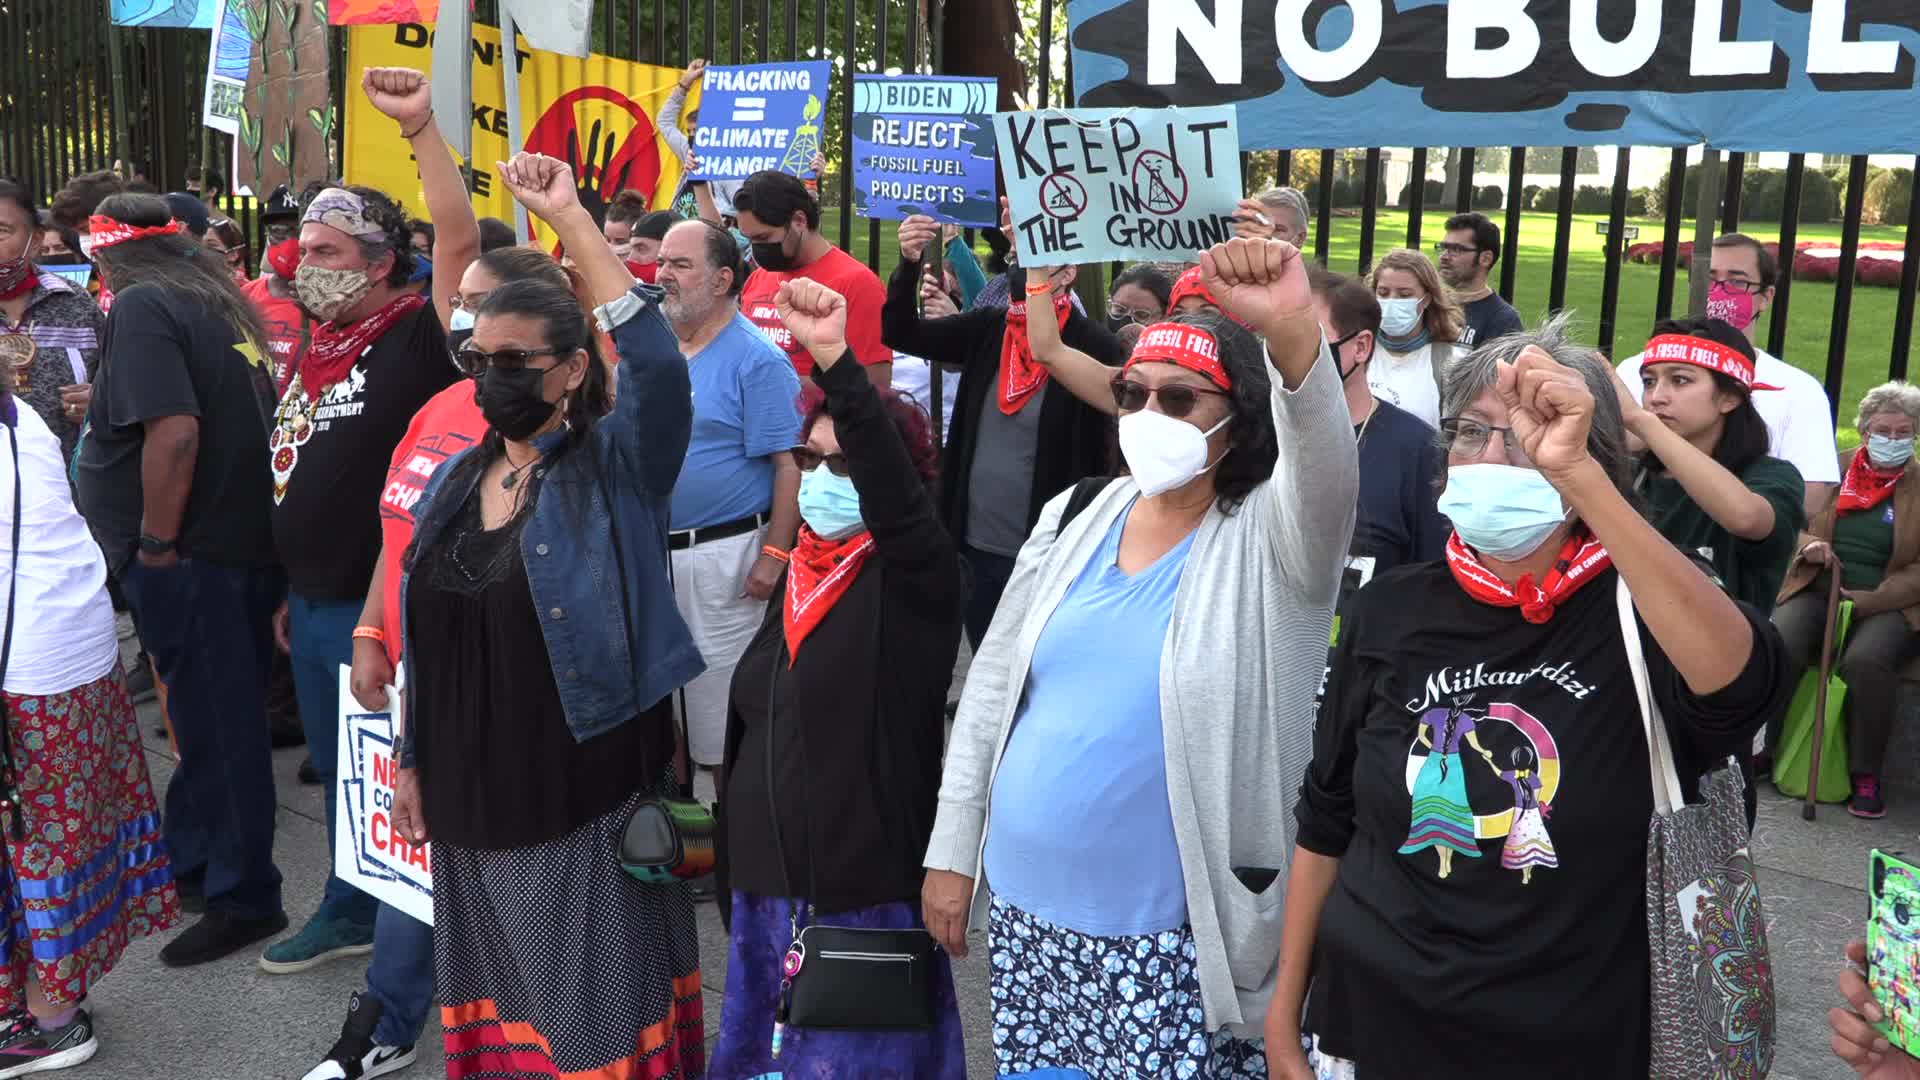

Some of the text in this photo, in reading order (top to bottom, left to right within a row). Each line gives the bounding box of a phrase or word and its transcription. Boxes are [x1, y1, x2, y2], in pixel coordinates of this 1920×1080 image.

[395, 22, 530, 74] DN'T
[1147, 0, 1901, 84] NO BULL
[703, 70, 811, 91] FRACKING
[887, 85, 953, 108] BIDEN
[695, 127, 789, 149] CLIMATE
[872, 119, 967, 149] REJECT
[1007, 115, 1228, 180] KEEP IT
[690, 156, 778, 176] CHANGE
[871, 155, 965, 176] FOSSIL FUEL
[872, 180, 966, 204] PROJECTS
[1110, 182, 1143, 213] IN
[1018, 213, 1084, 256] THE
[1144, 329, 1184, 349] FOSSIL
[1655, 343, 1688, 361] FOSSIL
[1690, 348, 1720, 368] FUELS
[384, 481, 423, 511] CHA
[371, 811, 434, 875] CHA
